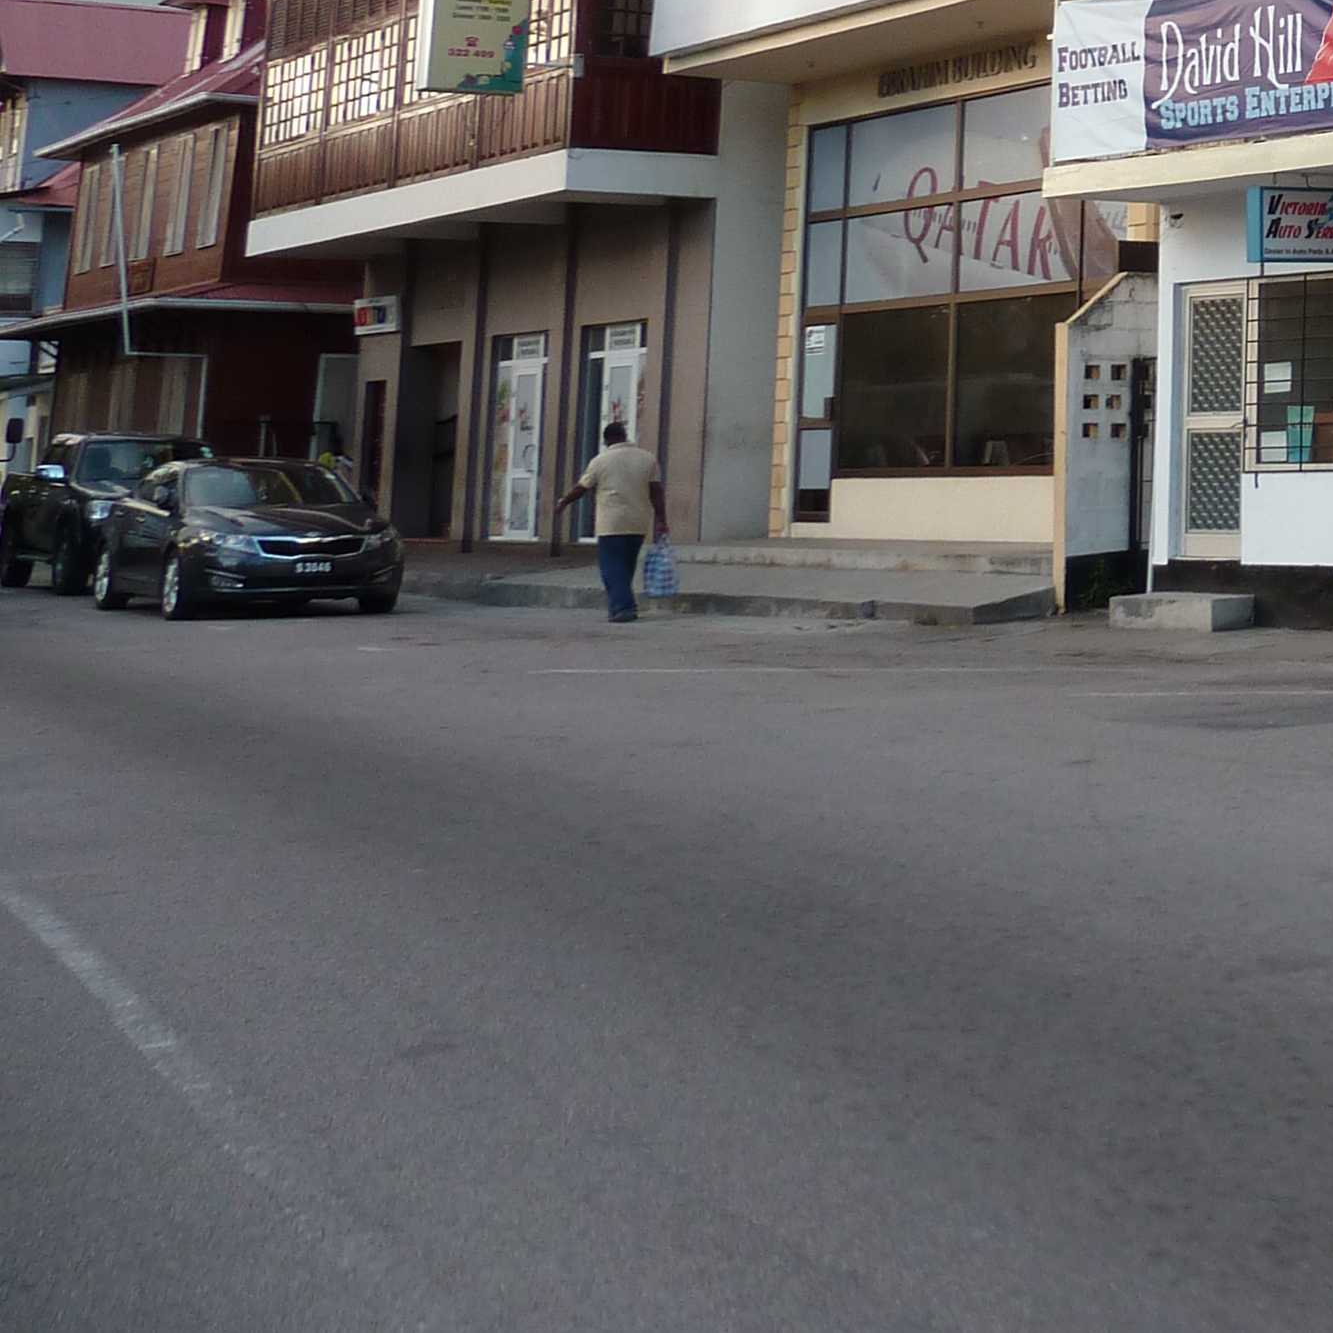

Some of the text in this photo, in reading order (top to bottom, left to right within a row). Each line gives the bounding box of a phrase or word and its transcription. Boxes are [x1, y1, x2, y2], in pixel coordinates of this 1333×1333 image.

[951, 41, 1037, 84] BUILDING
[1057, 41, 1141, 74] FOOTBALL
[1152, 4, 1303, 109] David Hill
[1058, 78, 1129, 109] BETTING
[1160, 95, 1240, 131] SPORTS
[1267, 194, 1328, 216] VICTORIA
[903, 167, 1054, 281] QATAR
[1265, 217, 1302, 239] AUTO
